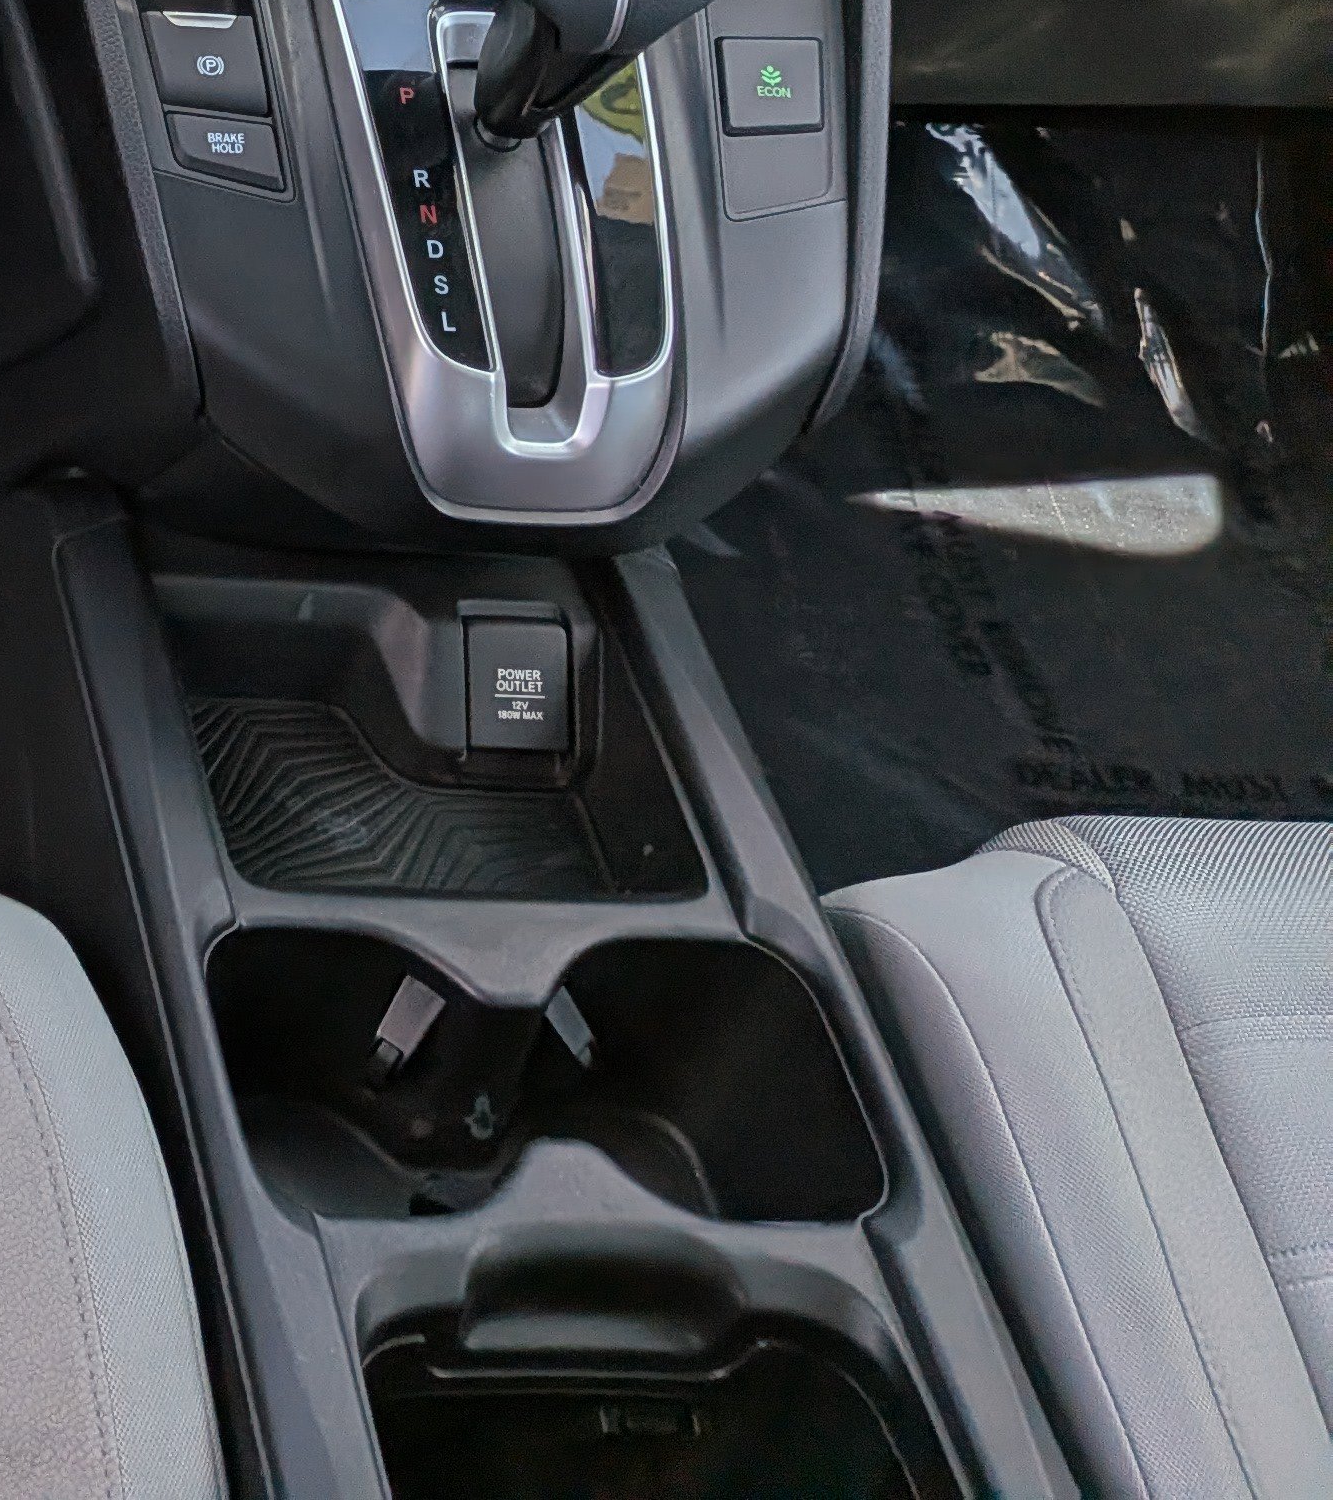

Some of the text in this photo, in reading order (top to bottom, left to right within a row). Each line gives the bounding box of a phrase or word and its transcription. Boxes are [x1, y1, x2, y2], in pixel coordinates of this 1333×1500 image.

[399, 87, 414, 104] P
[757, 85, 791, 98] ECON
[207, 132, 245, 145] BRAKE
[211, 143, 243, 155] HOLD
[413, 170, 431, 188] R
[420, 204, 438, 223] N
[427, 240, 444, 259] D
[434, 275, 449, 296] S
[442, 312, 456, 332] L
[497, 668, 541, 681] POWER
[496, 680, 543, 693] OUTLET
[511, 701, 528, 711] 12V
[497, 710, 544, 721] 180W MAX
